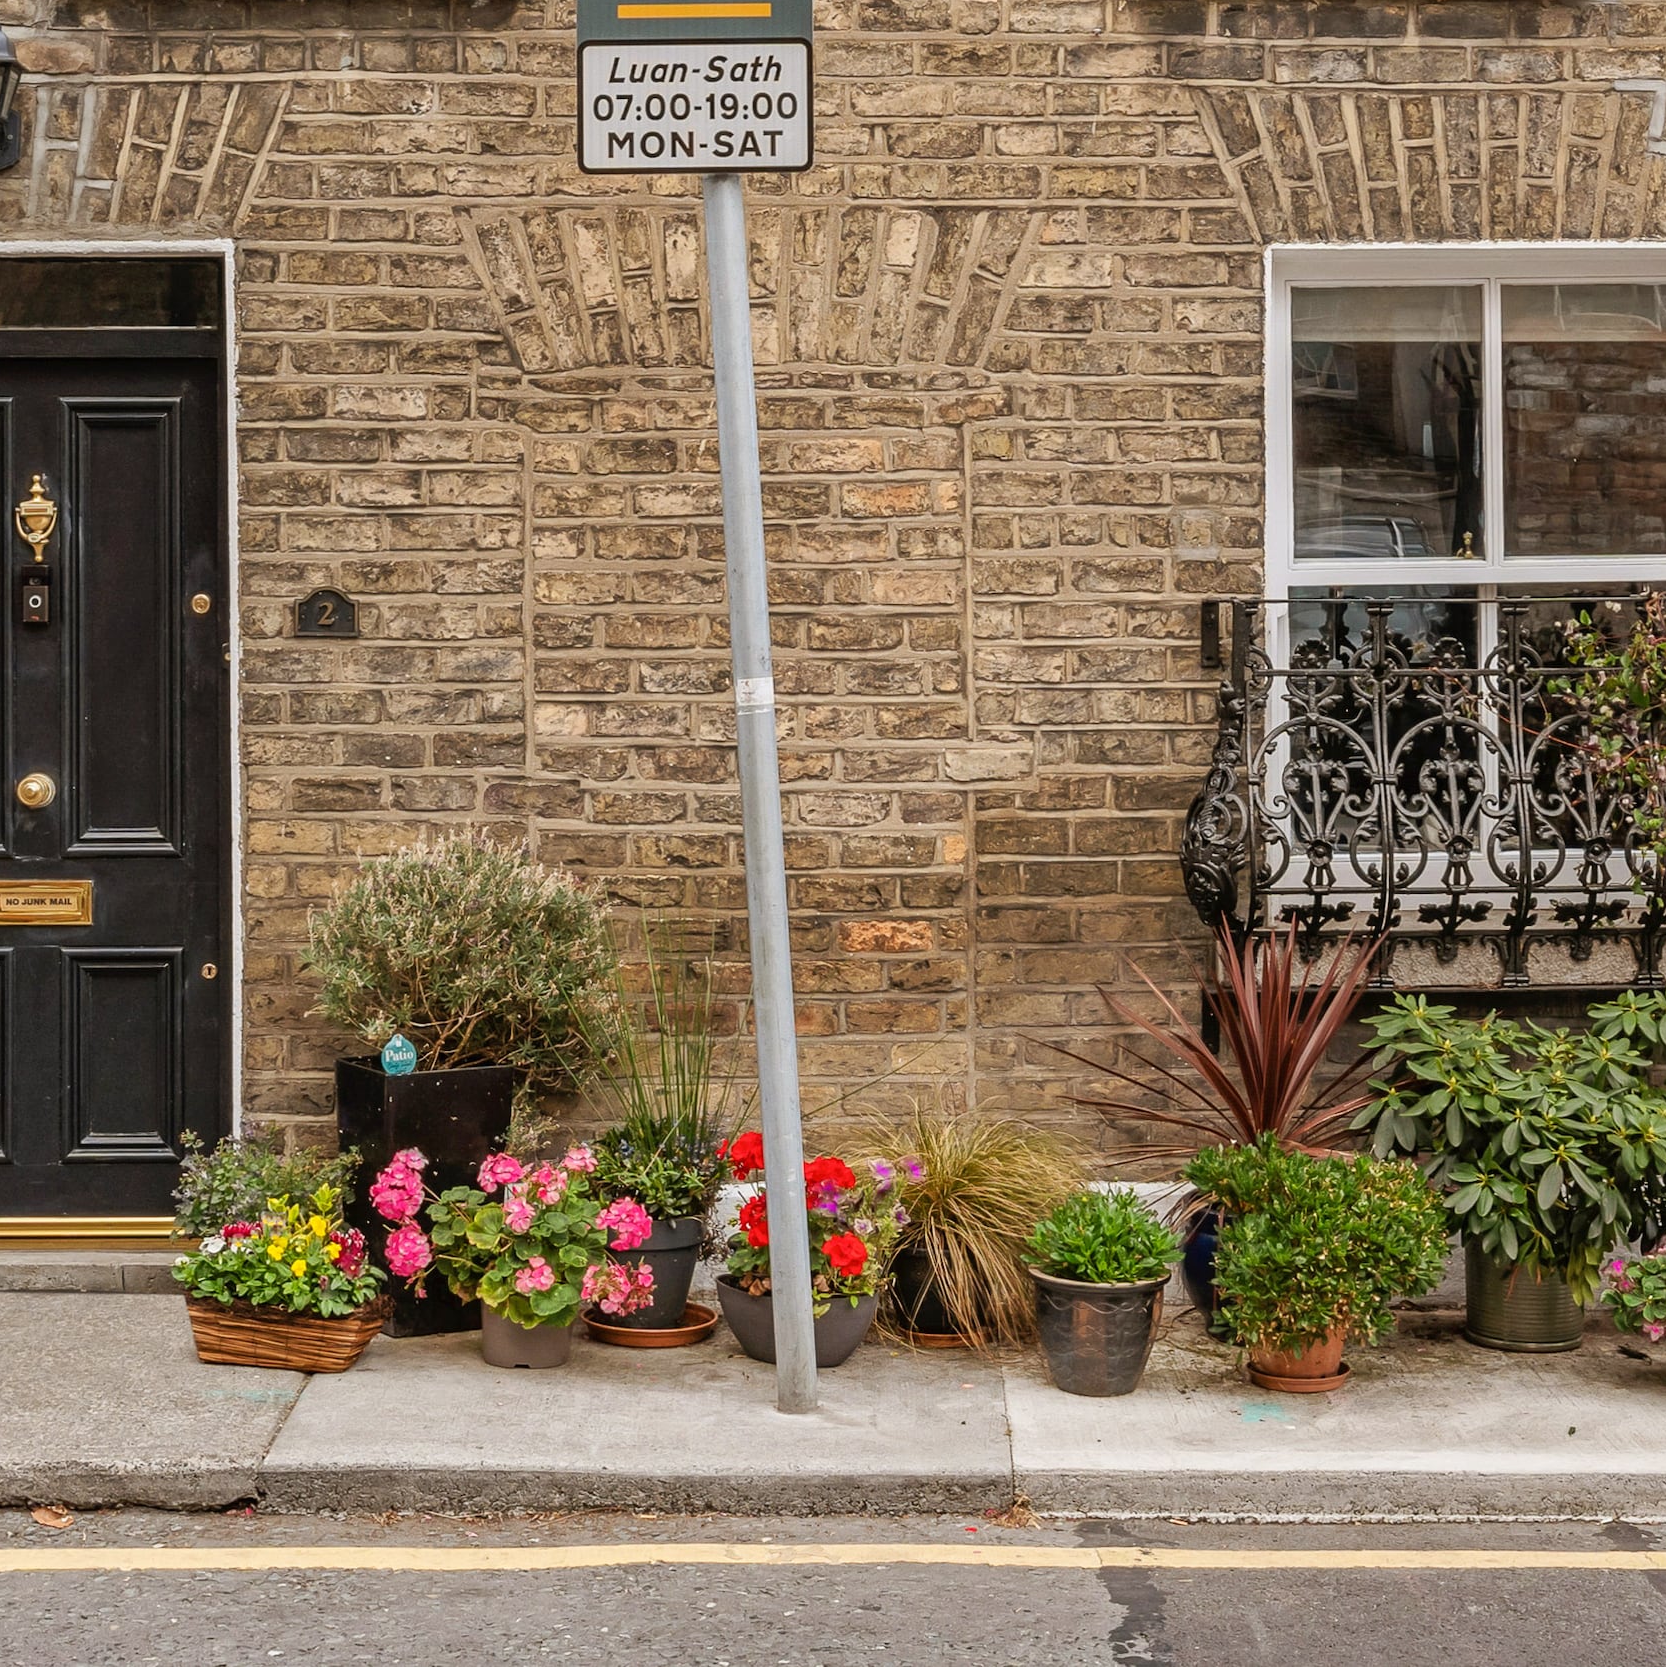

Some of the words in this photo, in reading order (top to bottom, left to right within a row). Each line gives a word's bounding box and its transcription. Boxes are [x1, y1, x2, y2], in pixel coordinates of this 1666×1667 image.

[608, 55, 782, 84] Luan-Sath
[593, 92, 798, 122] 07:00-19:00
[607, 130, 784, 159] MON-SAT
[317, 601, 335, 626] 2
[5, 898, 20, 906] NO
[21, 898, 47, 906] JUNK
[49, 898, 72, 906] MAIL
[385, 1048, 414, 1062] Patio
